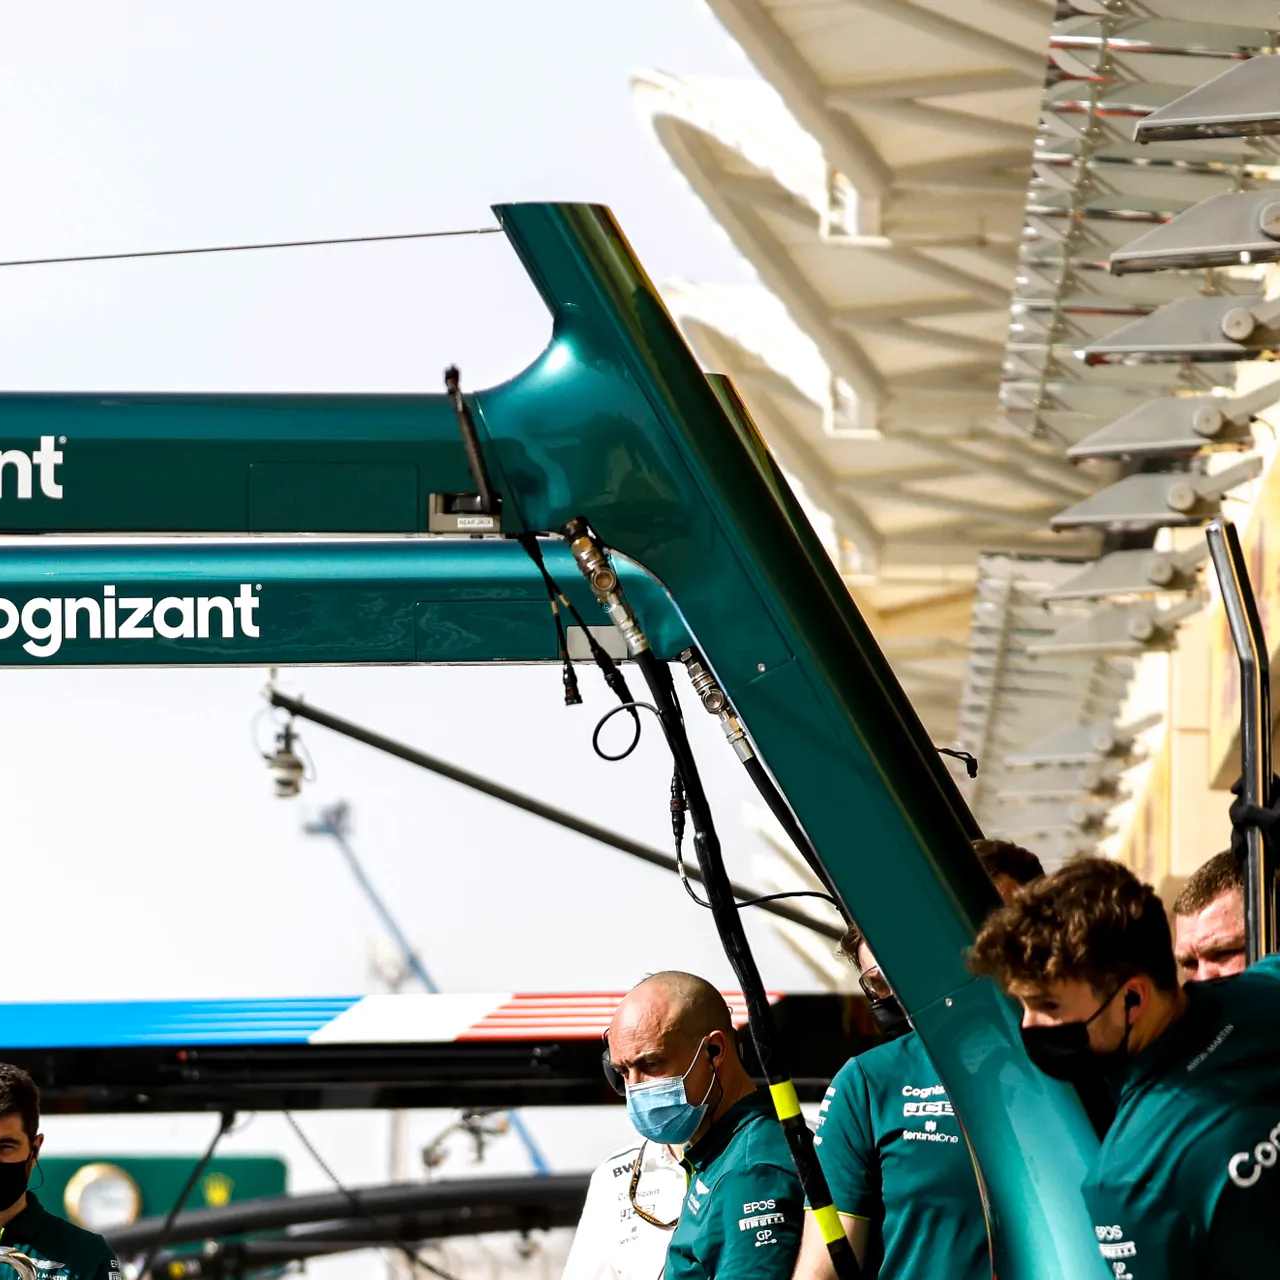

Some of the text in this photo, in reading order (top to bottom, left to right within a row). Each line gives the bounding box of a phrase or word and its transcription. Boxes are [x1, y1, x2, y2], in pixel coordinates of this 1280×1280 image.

[902, 1130, 959, 1143] SentinelOne
[743, 1199, 776, 1214] EPOS
[738, 1212, 785, 1232] PIRELLI
[756, 1229, 773, 1241] GP
